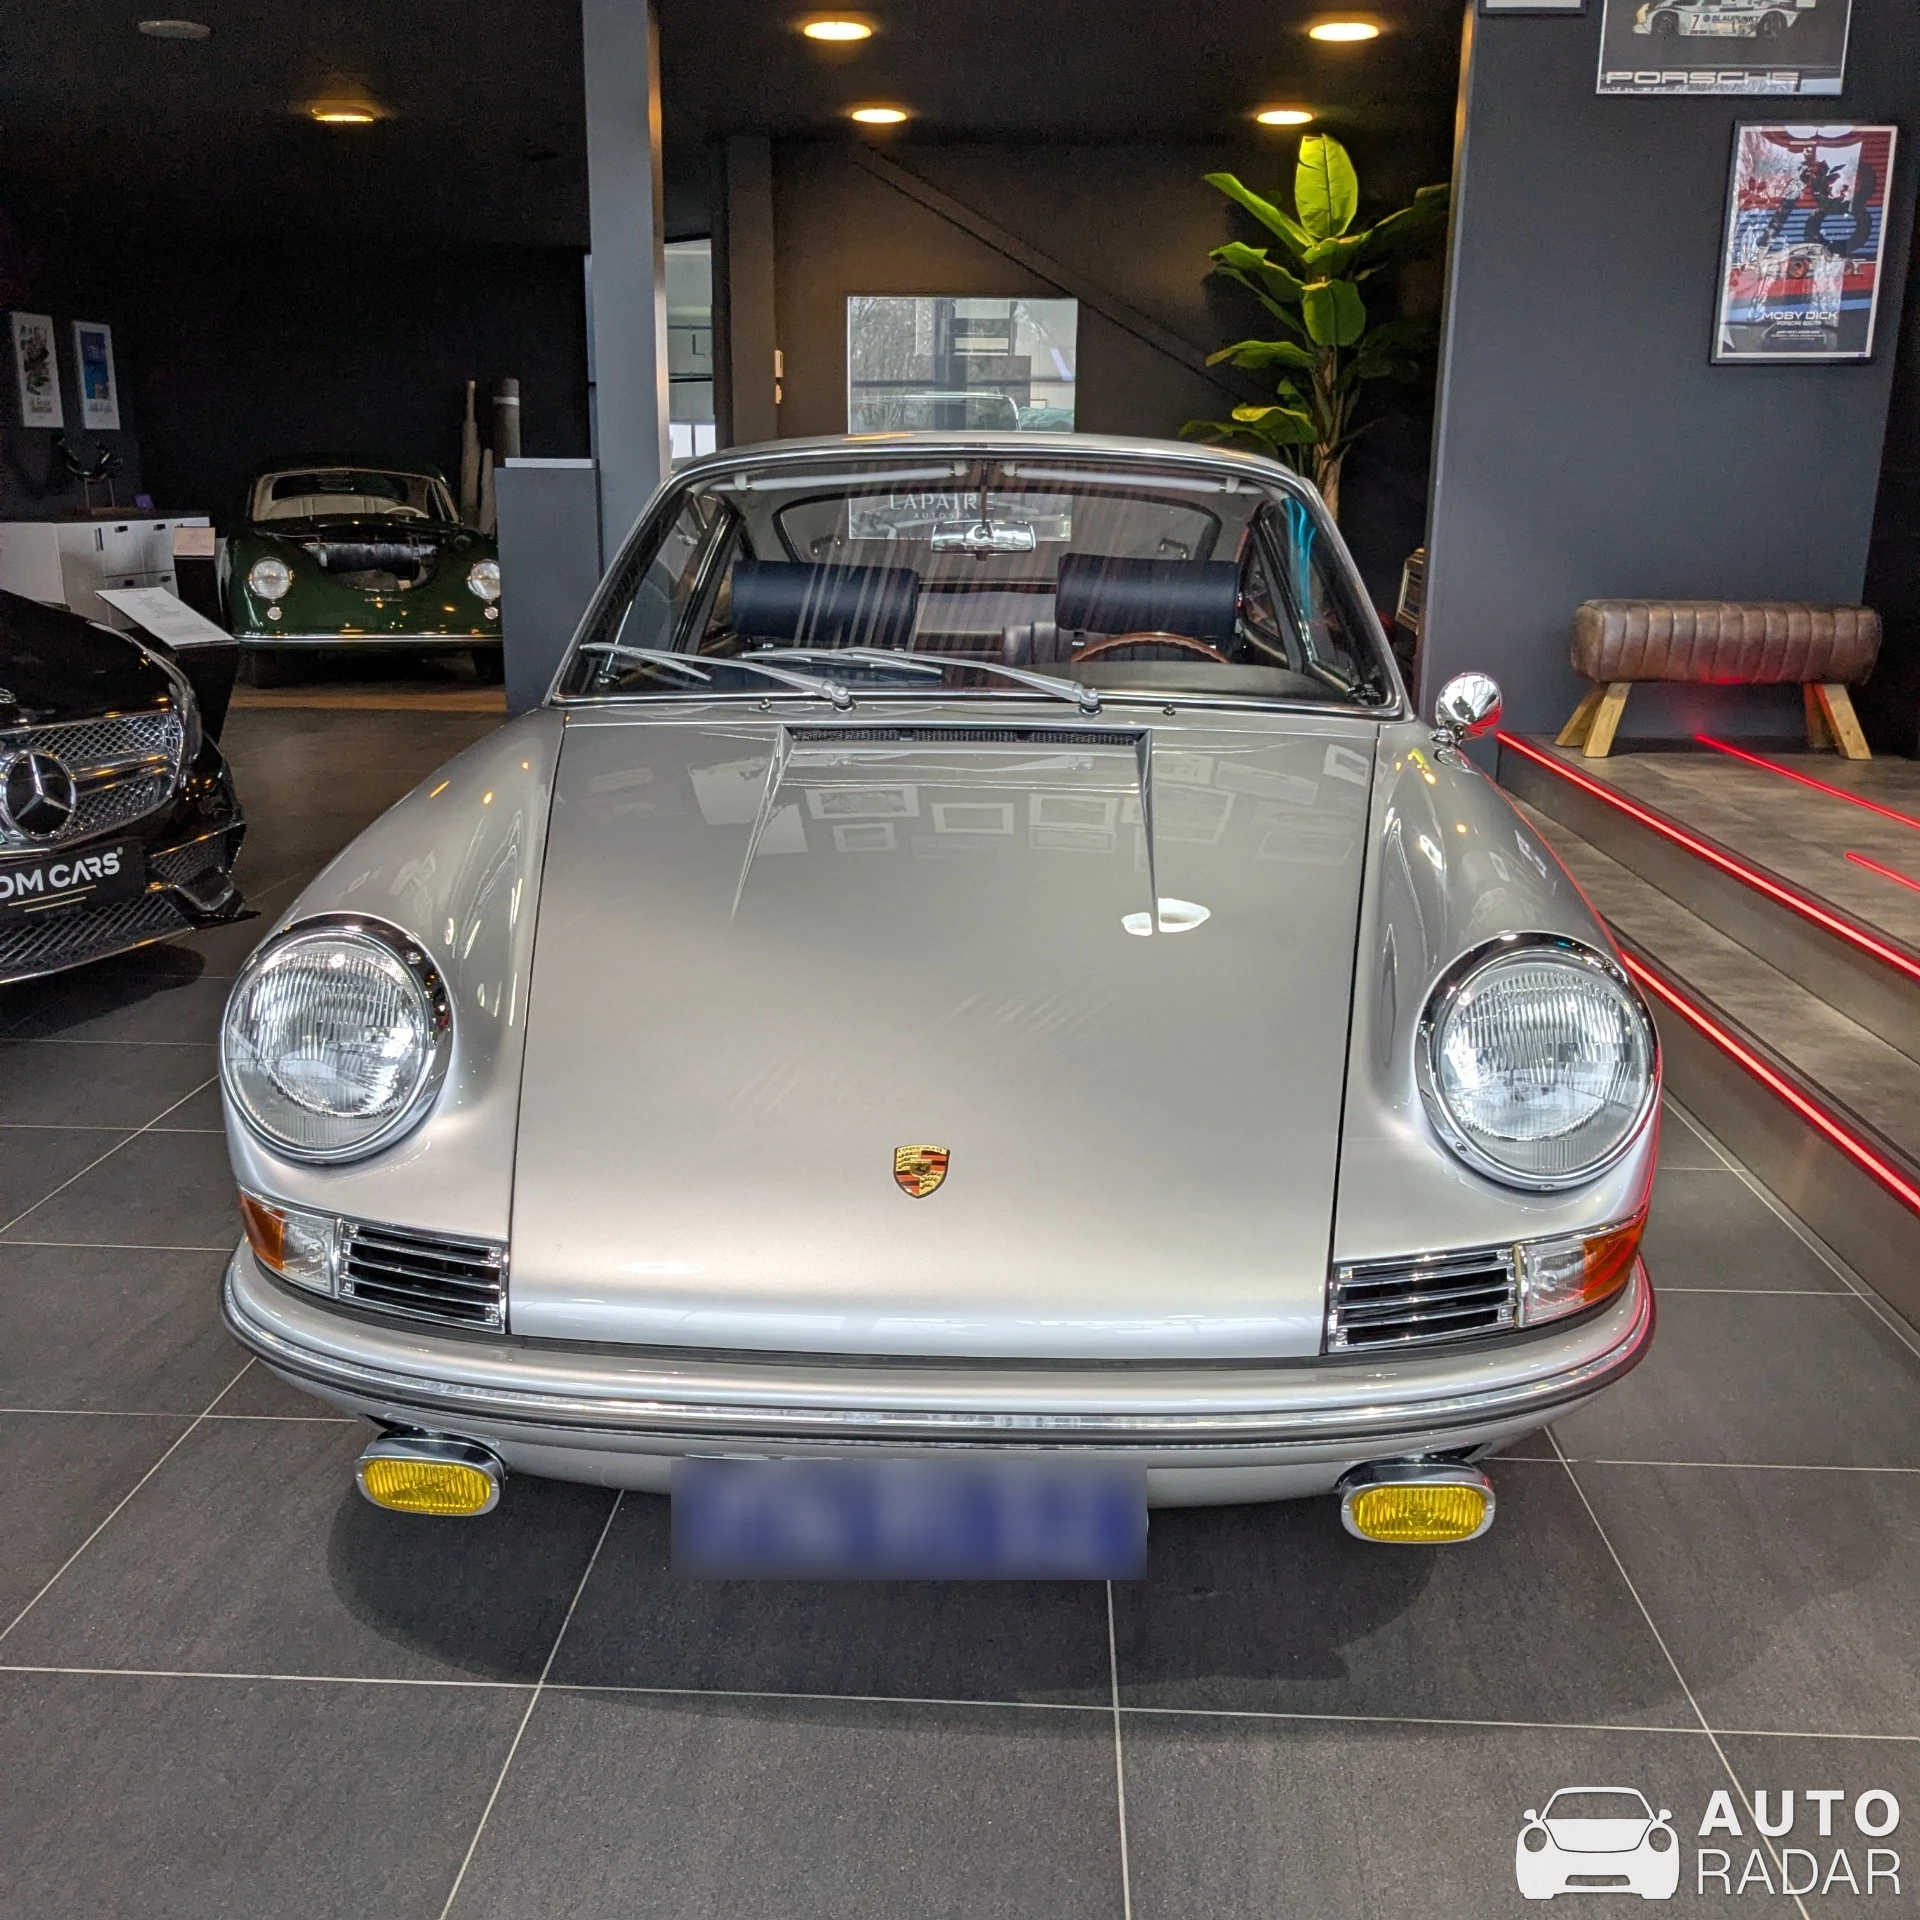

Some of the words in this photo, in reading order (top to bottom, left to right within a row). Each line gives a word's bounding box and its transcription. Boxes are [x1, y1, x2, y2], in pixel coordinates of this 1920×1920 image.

[1606, 71, 1799, 85] PORSCHE
[1762, 311, 1803, 320] MOBY
[1805, 311, 1838, 320] DICK
[890, 492, 995, 510] LAPAIRE
